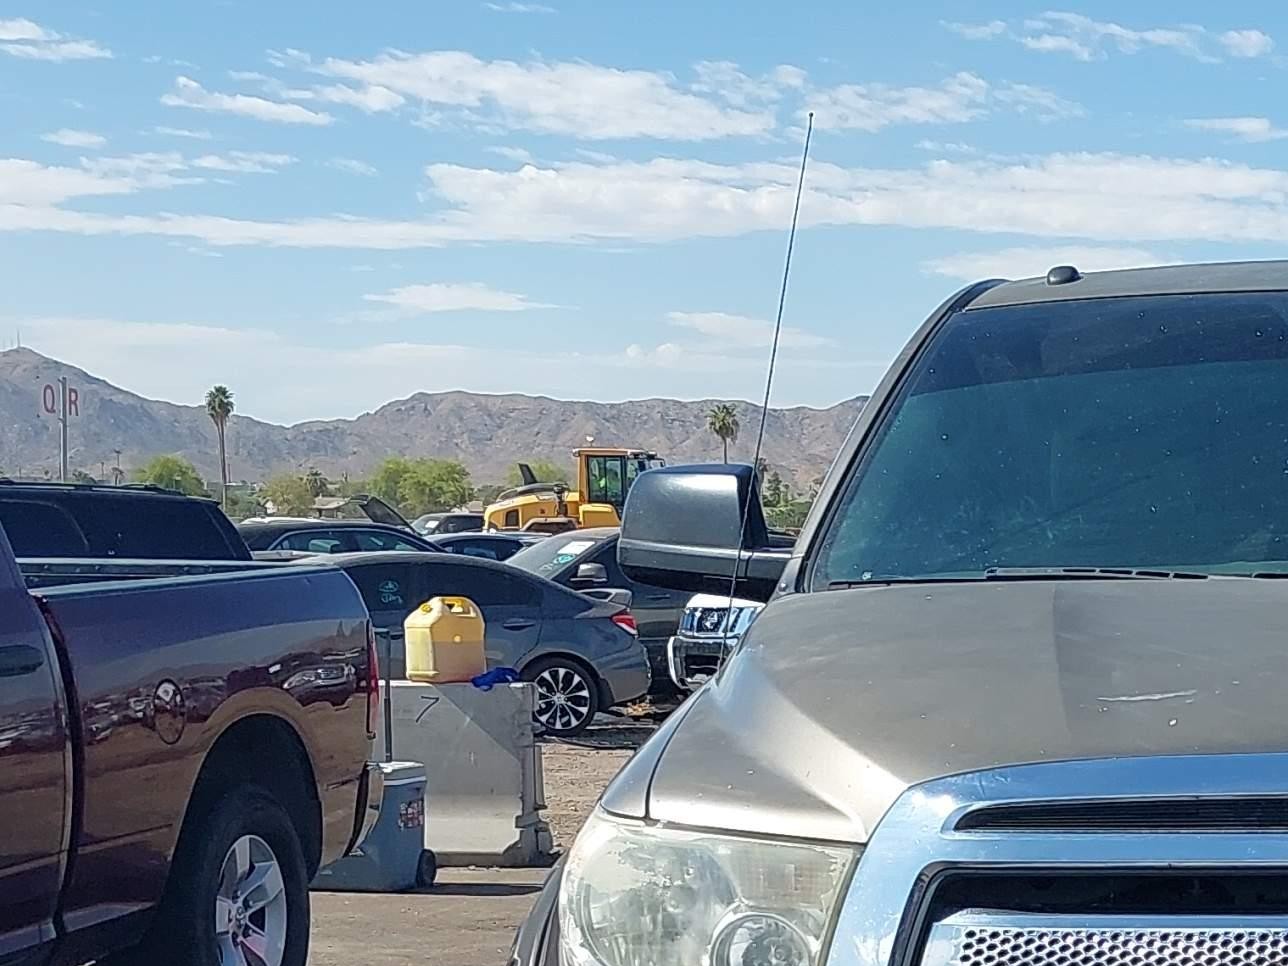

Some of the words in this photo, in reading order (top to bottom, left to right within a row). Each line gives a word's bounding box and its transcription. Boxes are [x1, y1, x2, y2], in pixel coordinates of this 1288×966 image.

[43, 384, 56, 414] Q
[68, 388, 79, 416] R
[415, 695, 440, 723] 7
